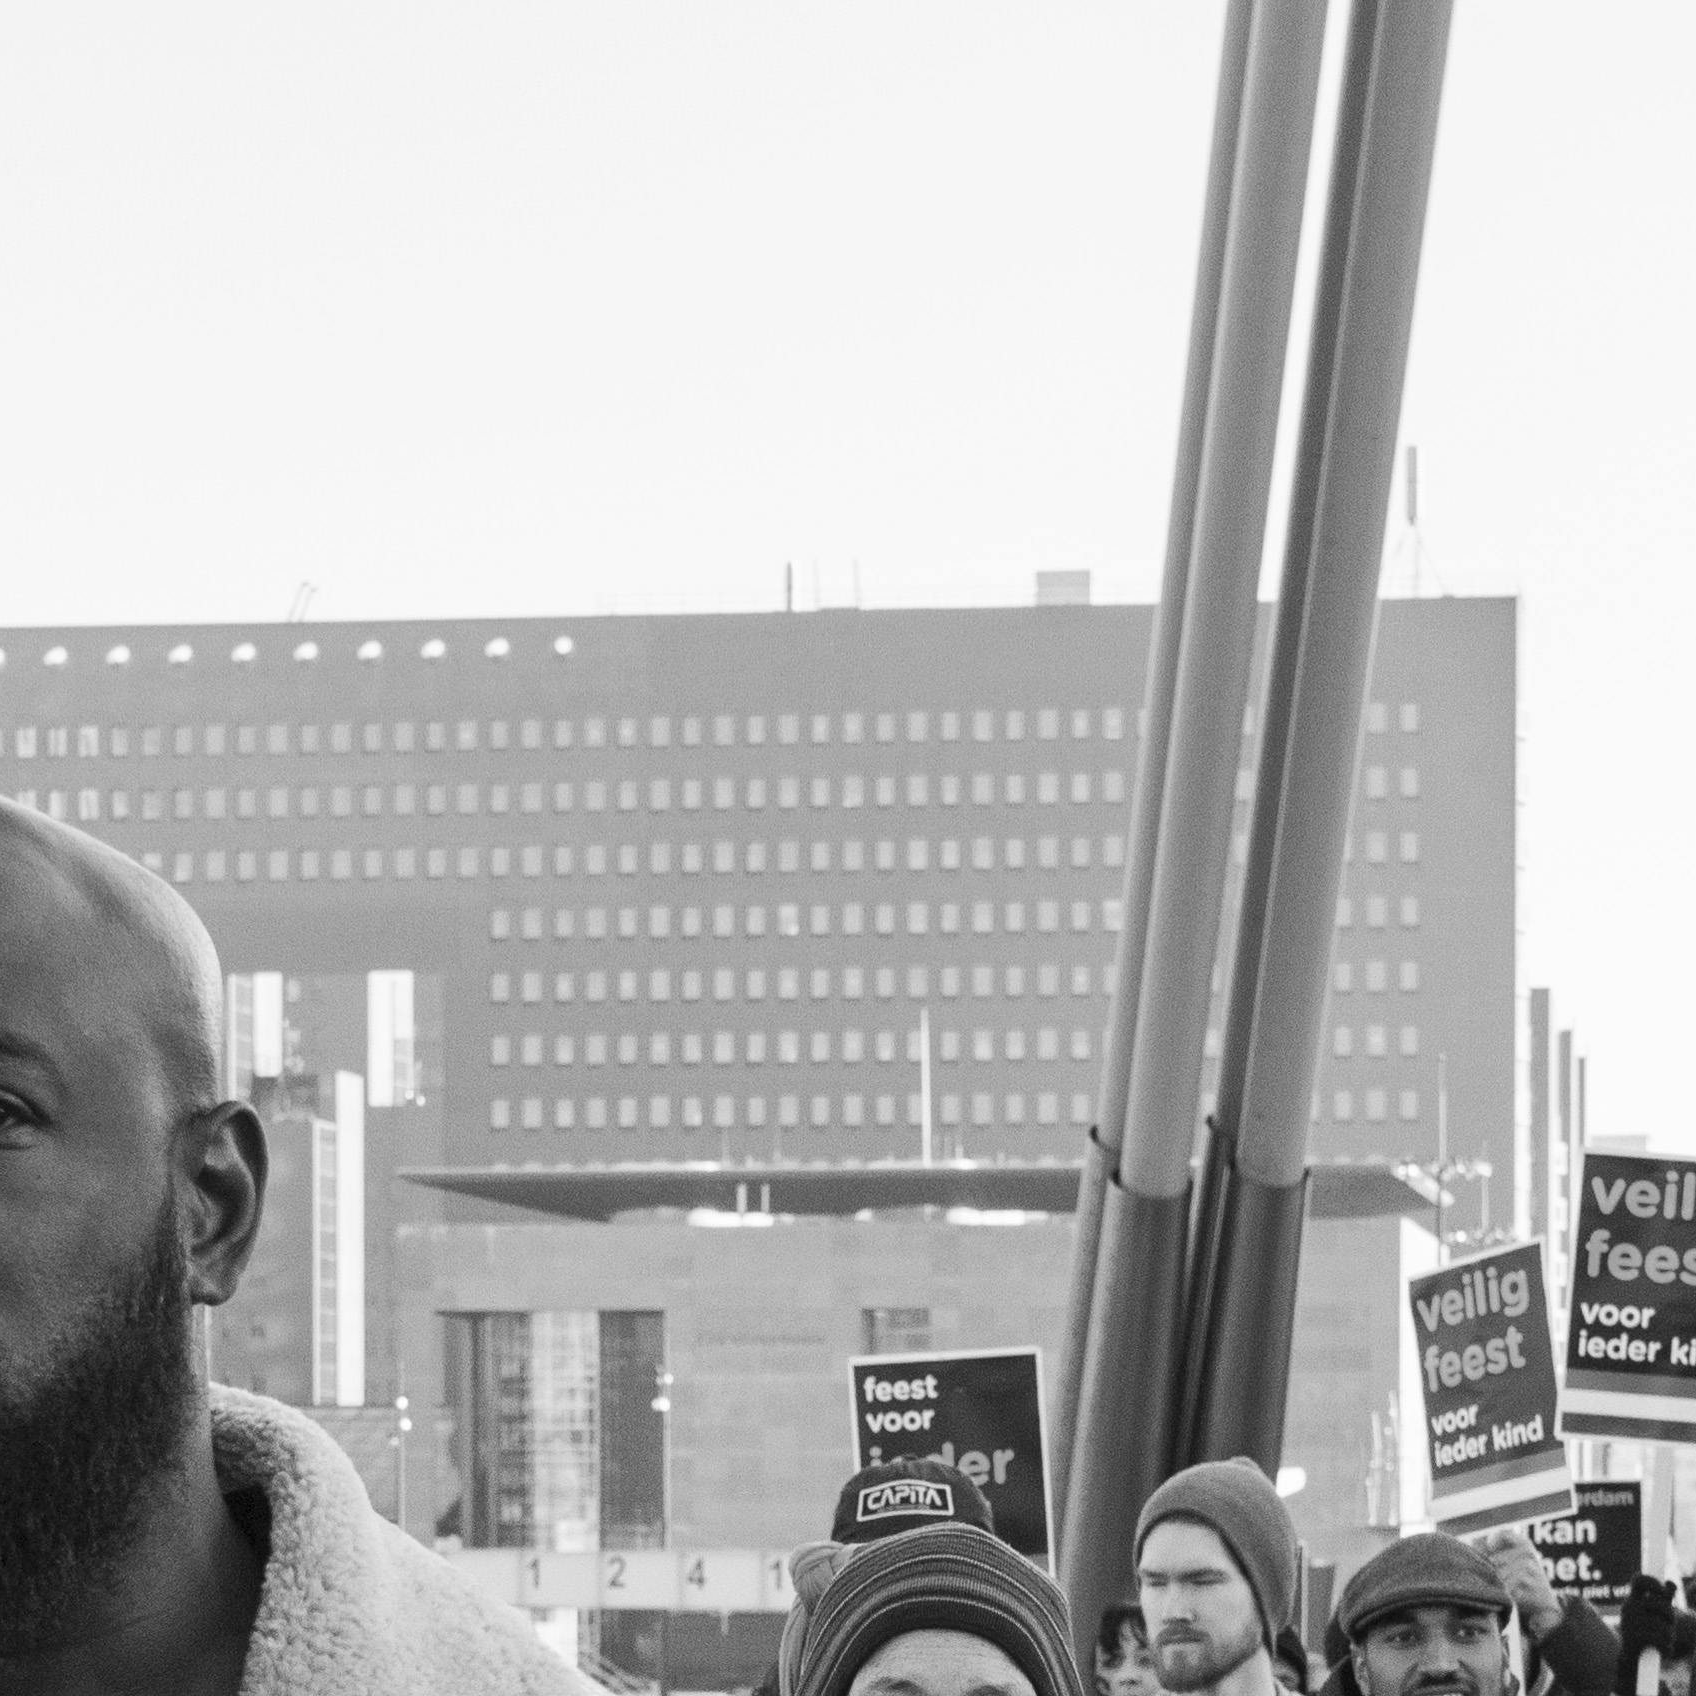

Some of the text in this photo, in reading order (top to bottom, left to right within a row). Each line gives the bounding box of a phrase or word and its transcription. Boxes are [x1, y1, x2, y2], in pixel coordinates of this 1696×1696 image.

[1417, 1266, 1529, 1332] veilig
[1580, 1302, 1655, 1329] voor
[1424, 1325, 1526, 1392] feest
[1578, 1329, 1661, 1362] ieder
[863, 1374, 938, 1403] feest
[865, 1409, 935, 1433] voor
[1431, 1404, 1479, 1436] voor
[1434, 1413, 1543, 1468] ieder kind
[867, 1485, 942, 1510] CAPITA
[1533, 1519, 1597, 1544] kan
